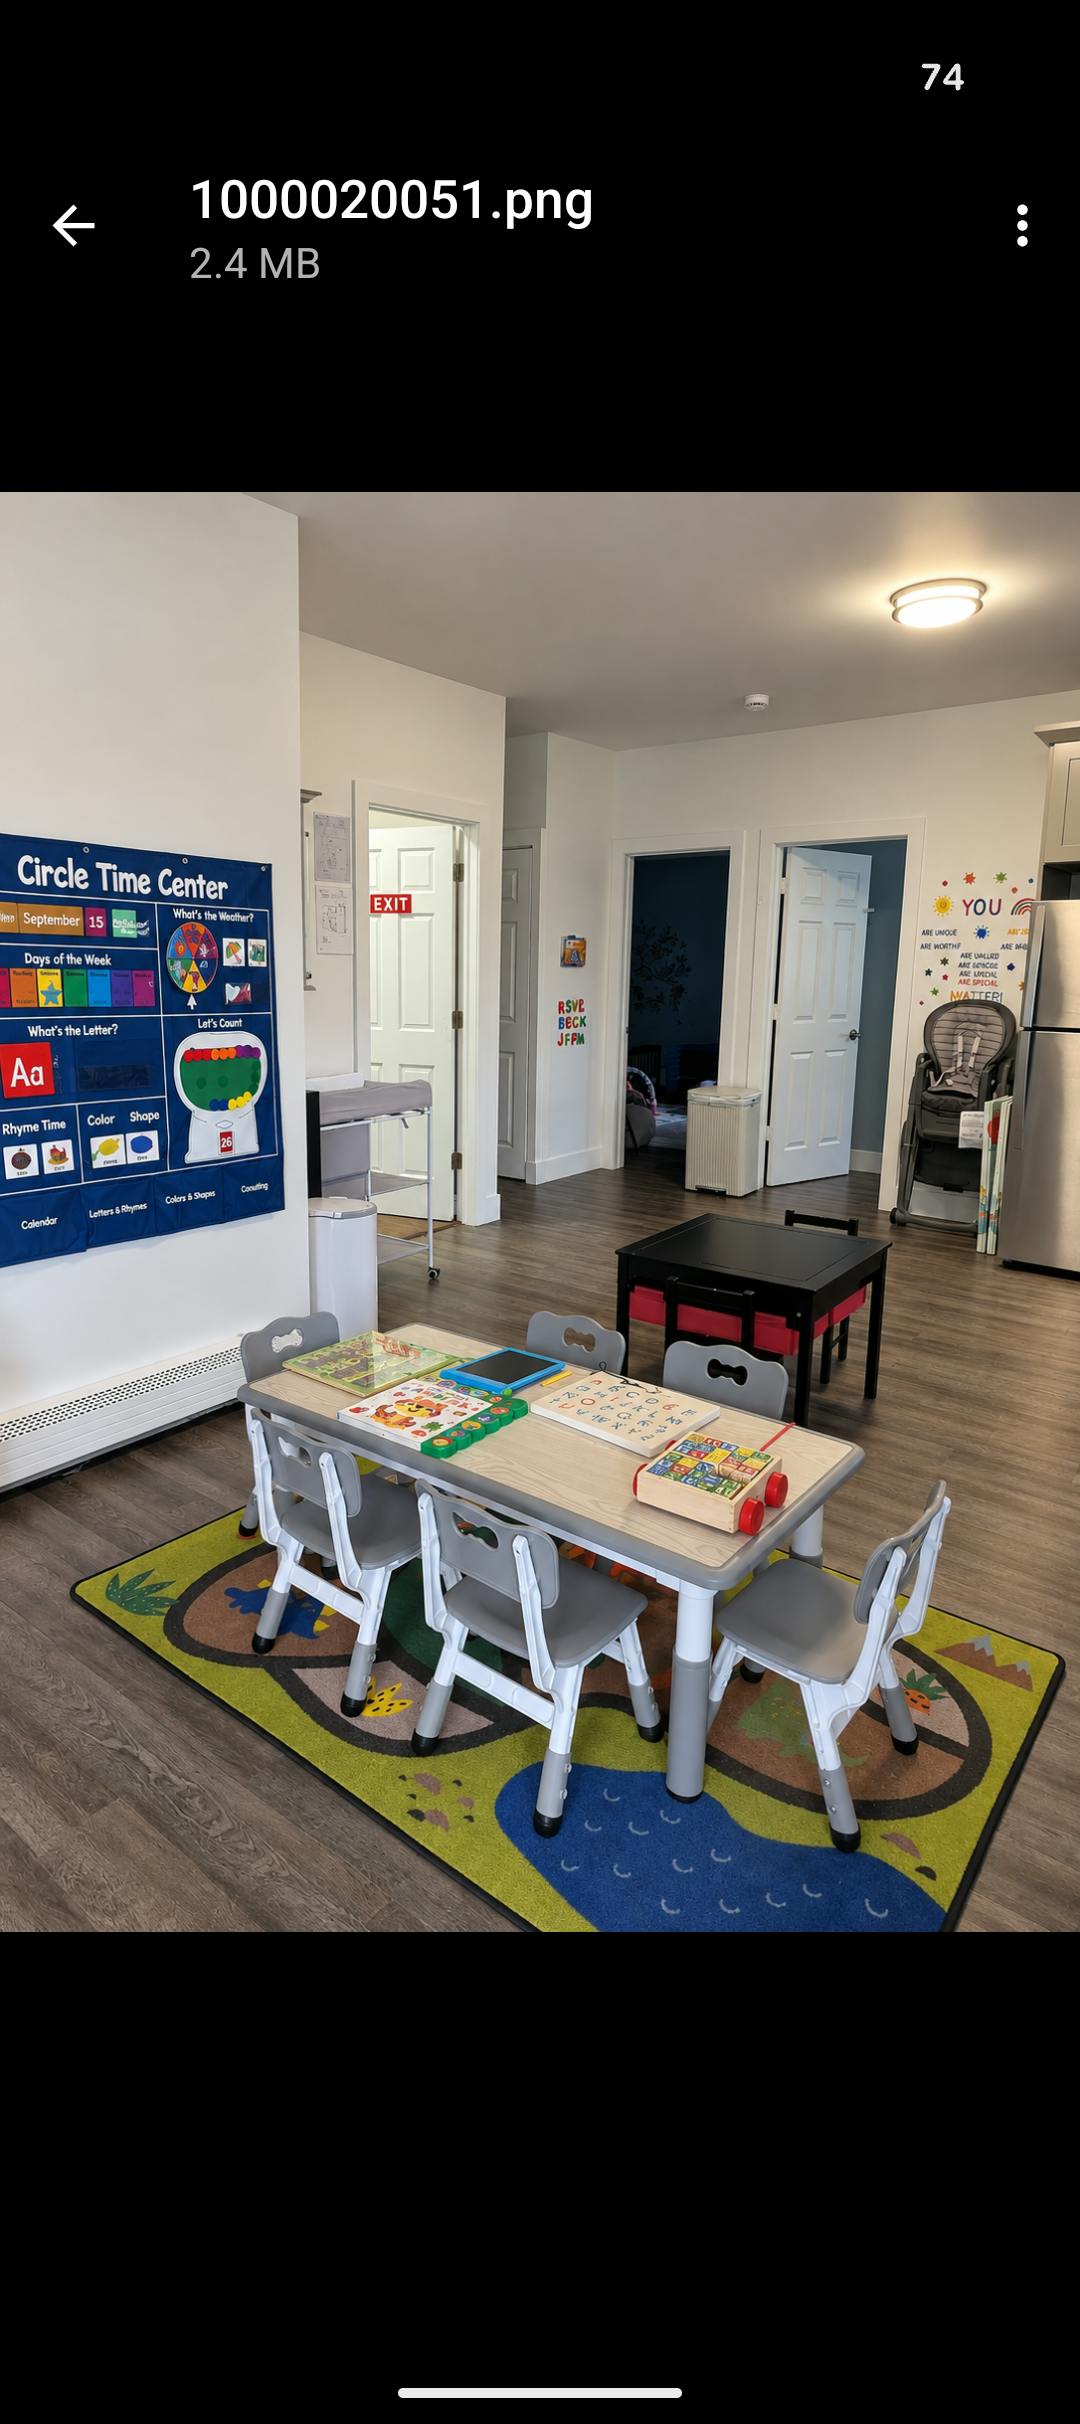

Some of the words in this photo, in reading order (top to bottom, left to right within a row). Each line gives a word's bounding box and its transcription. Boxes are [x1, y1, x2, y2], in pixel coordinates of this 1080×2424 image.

[17, 855, 89, 889] Circle
[95, 862, 151, 895] Time
[158, 868, 229, 900] Center
[373, 896, 409, 911] EXIT
[962, 898, 1002, 916] YOU
[23, 912, 80, 928] September
[89, 916, 104, 928] 15
[172, 908, 205, 920] What's
[205, 910, 217, 920] the
[218, 911, 254, 923] Weather?
[24, 952, 51, 967] Days
[53, 953, 65, 965] of
[66, 954, 82, 965] the
[84, 954, 112, 966] Week
[28, 1025, 64, 1037] What's
[65, 1025, 81, 1036] the
[83, 1024, 118, 1036] Letter?
[198, 1018, 217, 1029] Let's
[219, 1018, 242, 1028] Count
[10, 1057, 45, 1088] Aa
[87, 1114, 115, 1126] Color
[130, 1111, 160, 1124] Shape
[2, 1123, 39, 1136] Rhyme
[41, 1119, 66, 1131] Time
[221, 1137, 232, 1148] 26
[165, 1194, 186, 1204] Colors
[89, 1206, 114, 1218] Letters
[121, 1203, 148, 1215] Rhymes
[21, 1216, 58, 1230] Calendar
